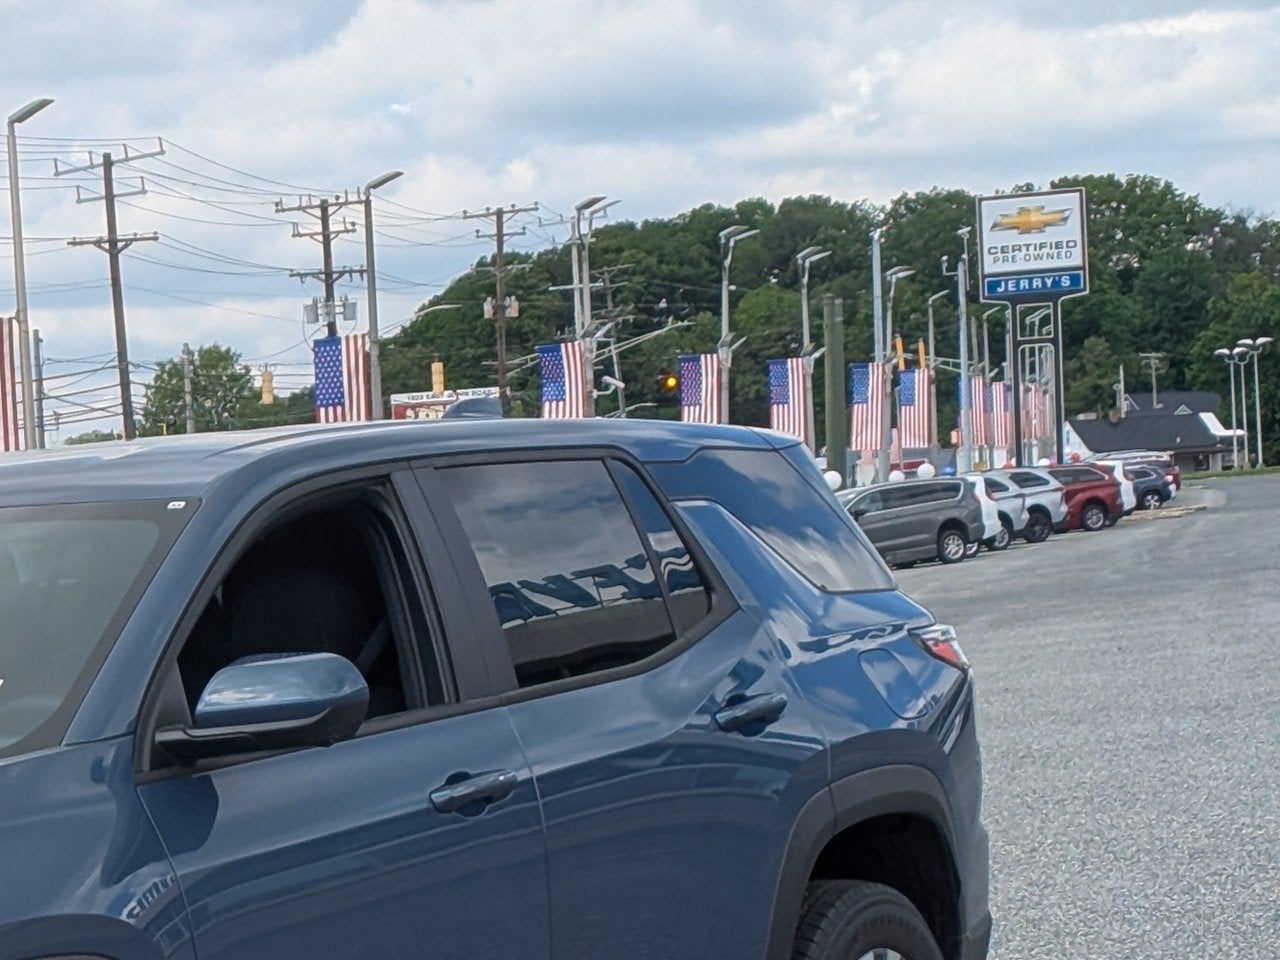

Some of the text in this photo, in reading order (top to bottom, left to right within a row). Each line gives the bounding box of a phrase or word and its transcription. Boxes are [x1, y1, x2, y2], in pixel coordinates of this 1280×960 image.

[987, 239, 1078, 255] CERTIFIED
[992, 250, 1073, 264] PRE-OWNED
[996, 275, 1071, 292] JERRY'S
